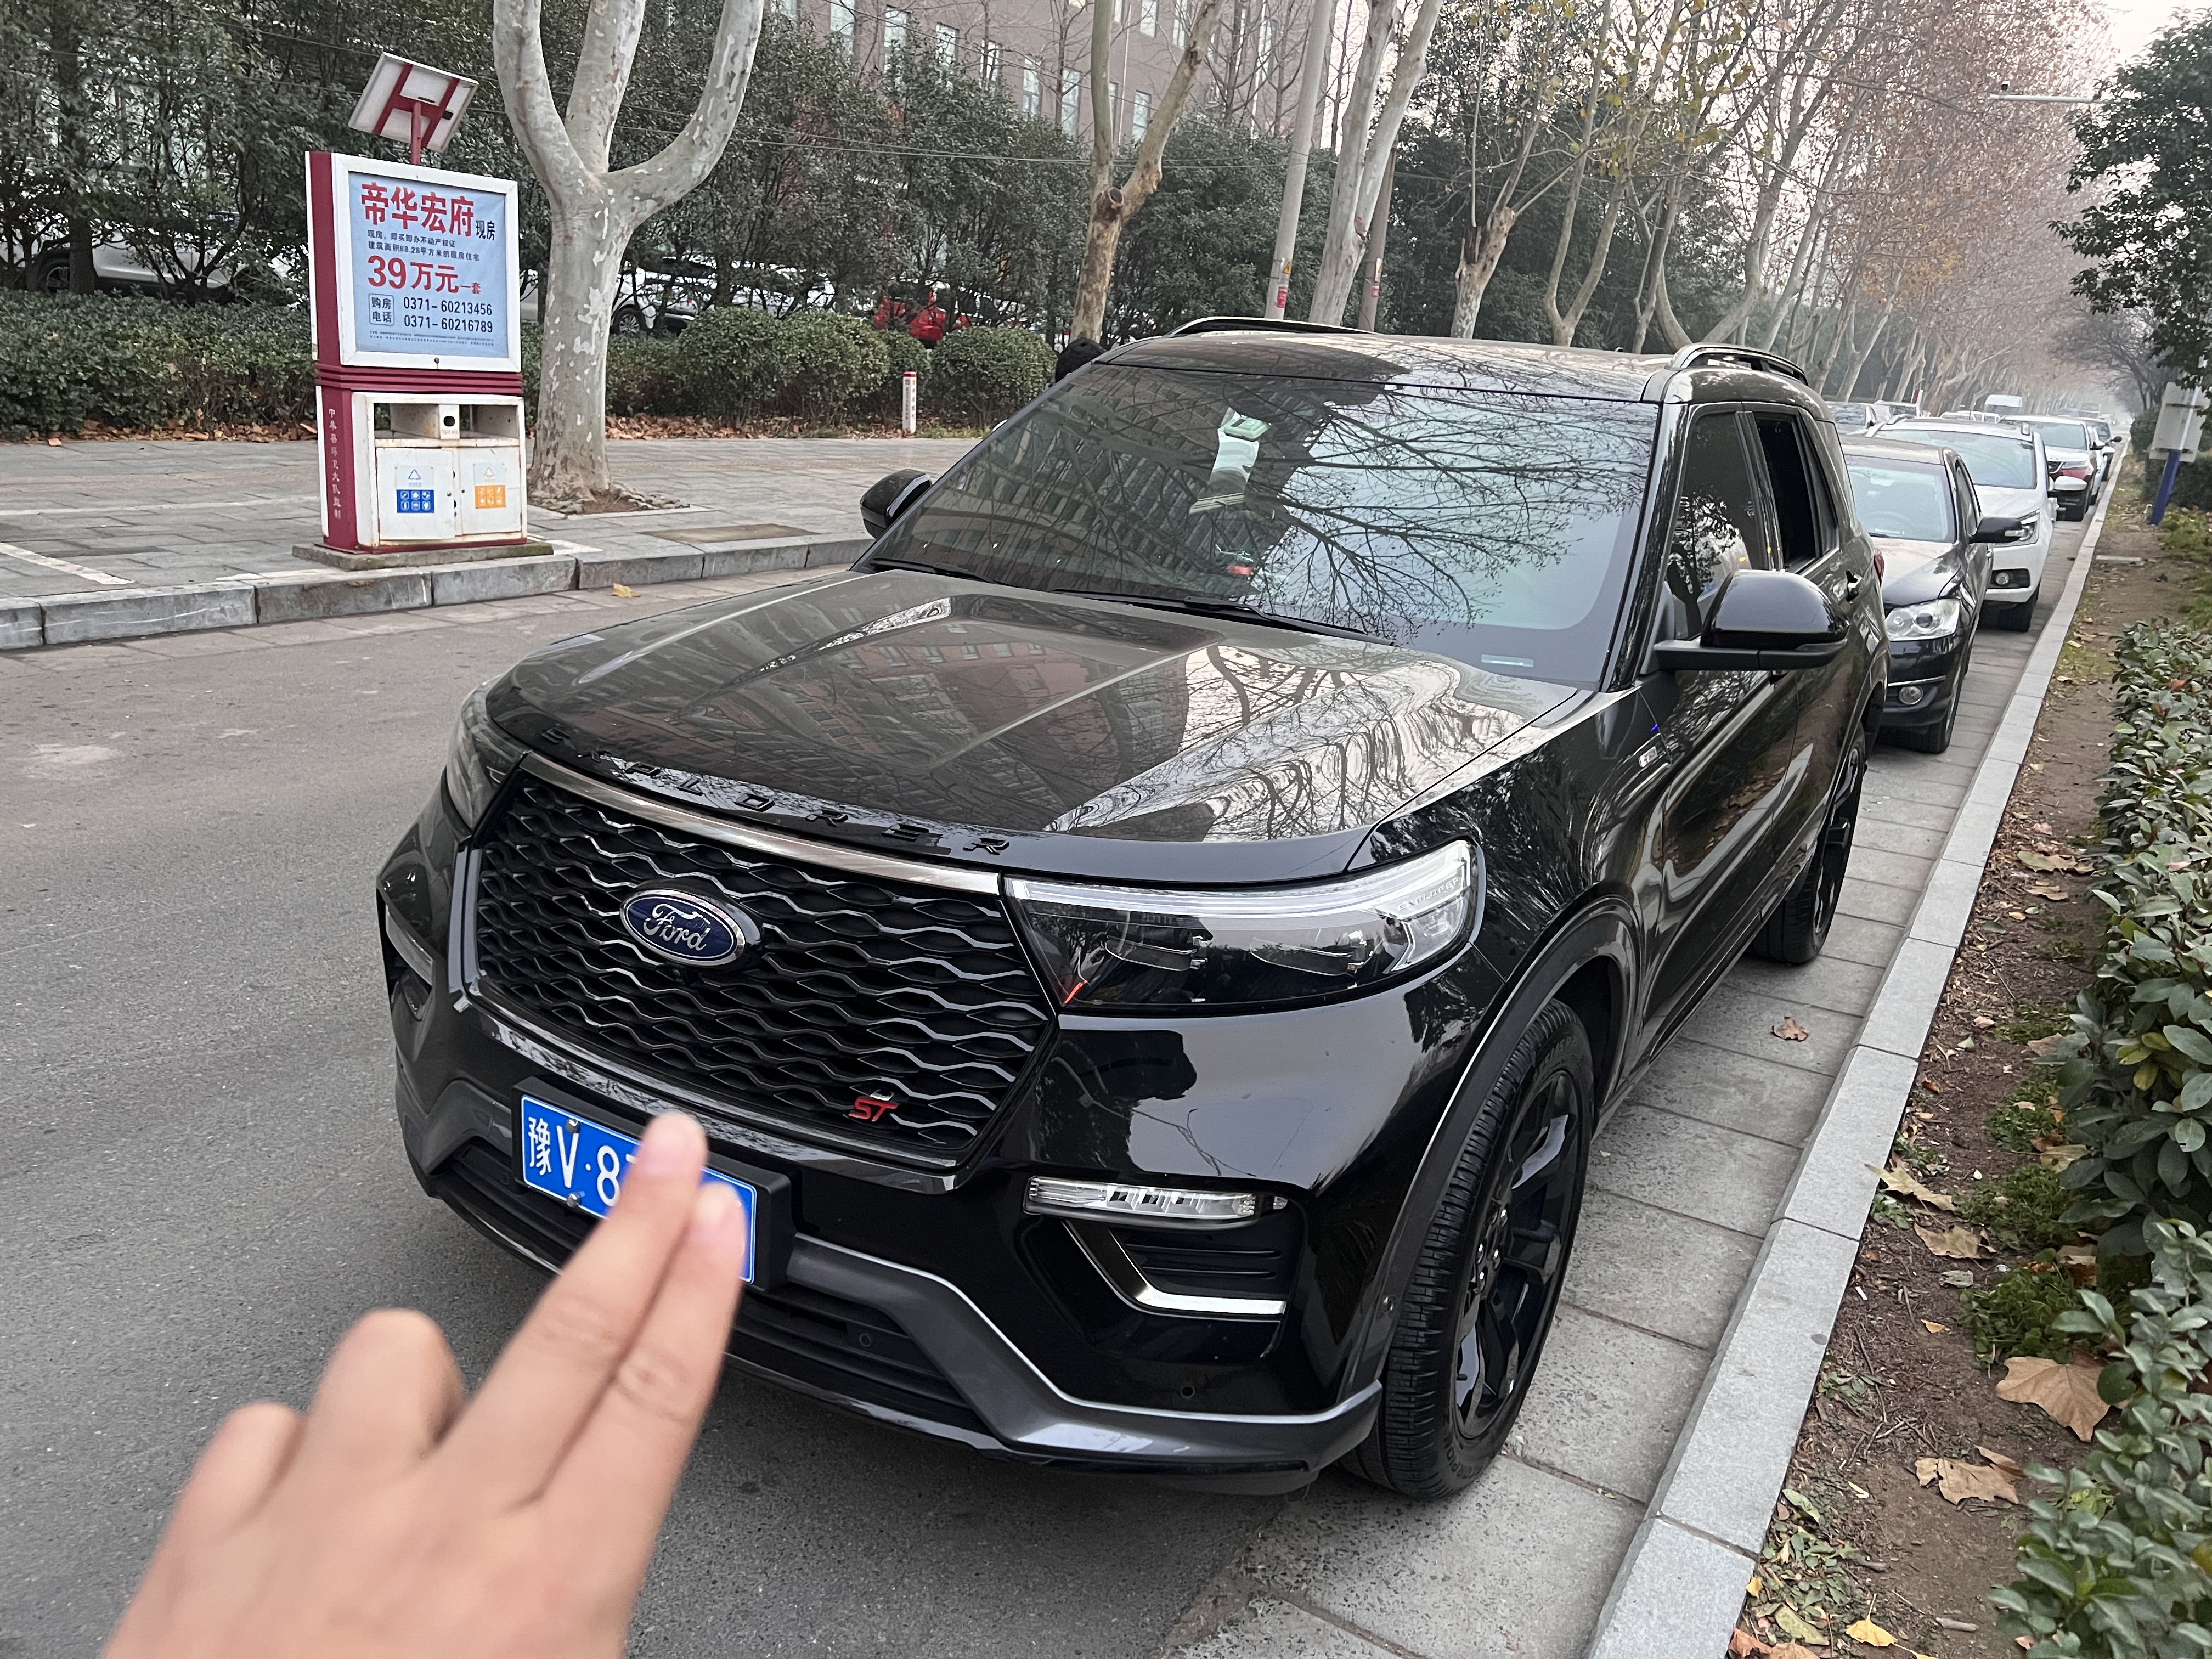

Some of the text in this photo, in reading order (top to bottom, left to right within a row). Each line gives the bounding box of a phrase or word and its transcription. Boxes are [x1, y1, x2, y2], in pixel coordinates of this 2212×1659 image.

[361, 182, 474, 238] 帝华宏府
[371, 297, 391, 309] 购房
[373, 311, 392, 323] 电话
[541, 727, 1010, 855] EXPLORER
[643, 902, 712, 953] Ford
[848, 1097, 899, 1122] ST
